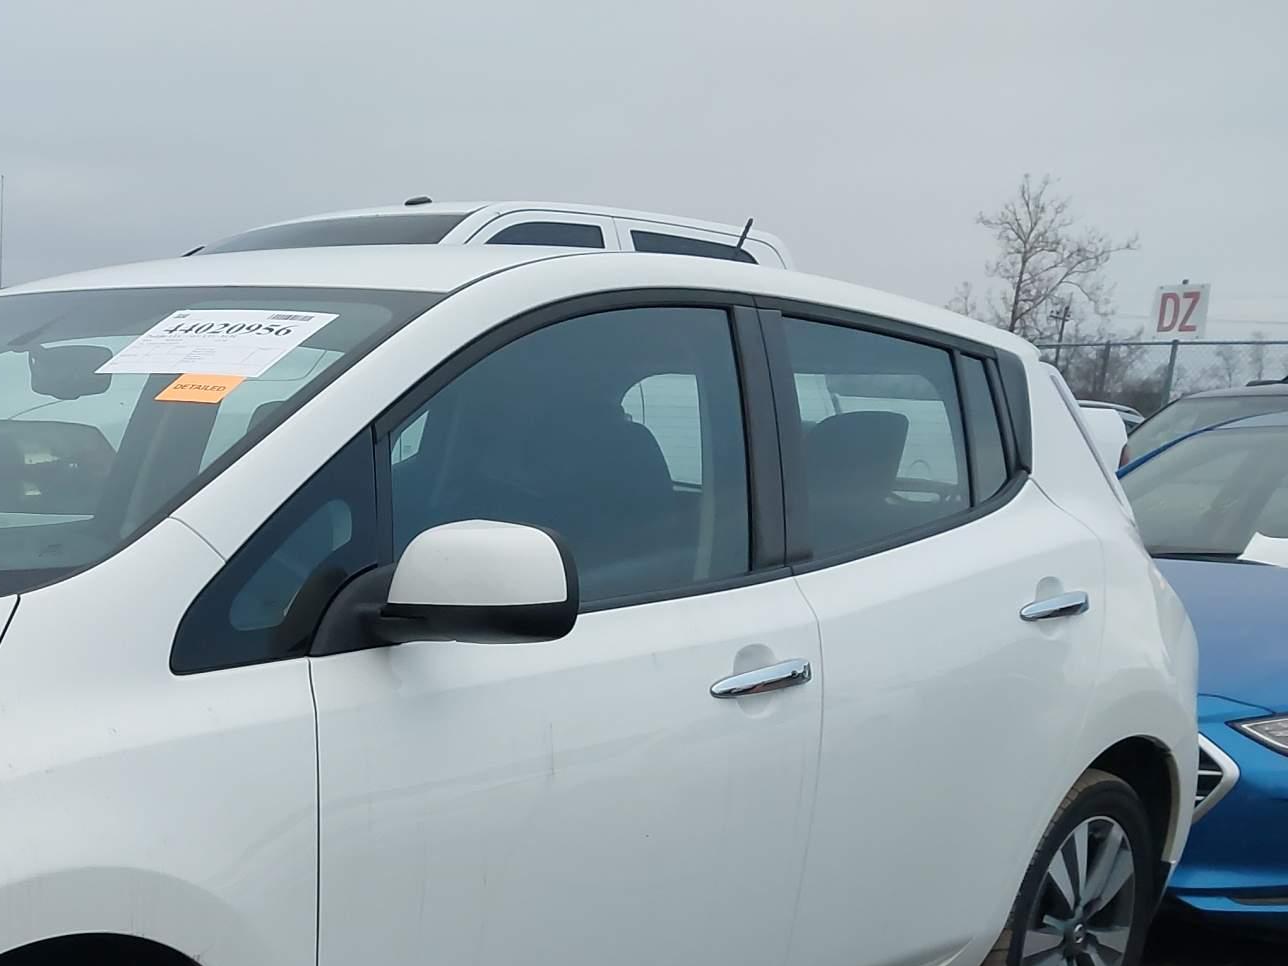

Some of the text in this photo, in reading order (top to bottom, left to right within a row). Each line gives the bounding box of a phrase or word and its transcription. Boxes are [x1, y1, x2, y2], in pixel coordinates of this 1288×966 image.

[1156, 290, 1201, 333] DZ
[163, 321, 296, 337] 44020956
[172, 383, 227, 393] DETAILED
